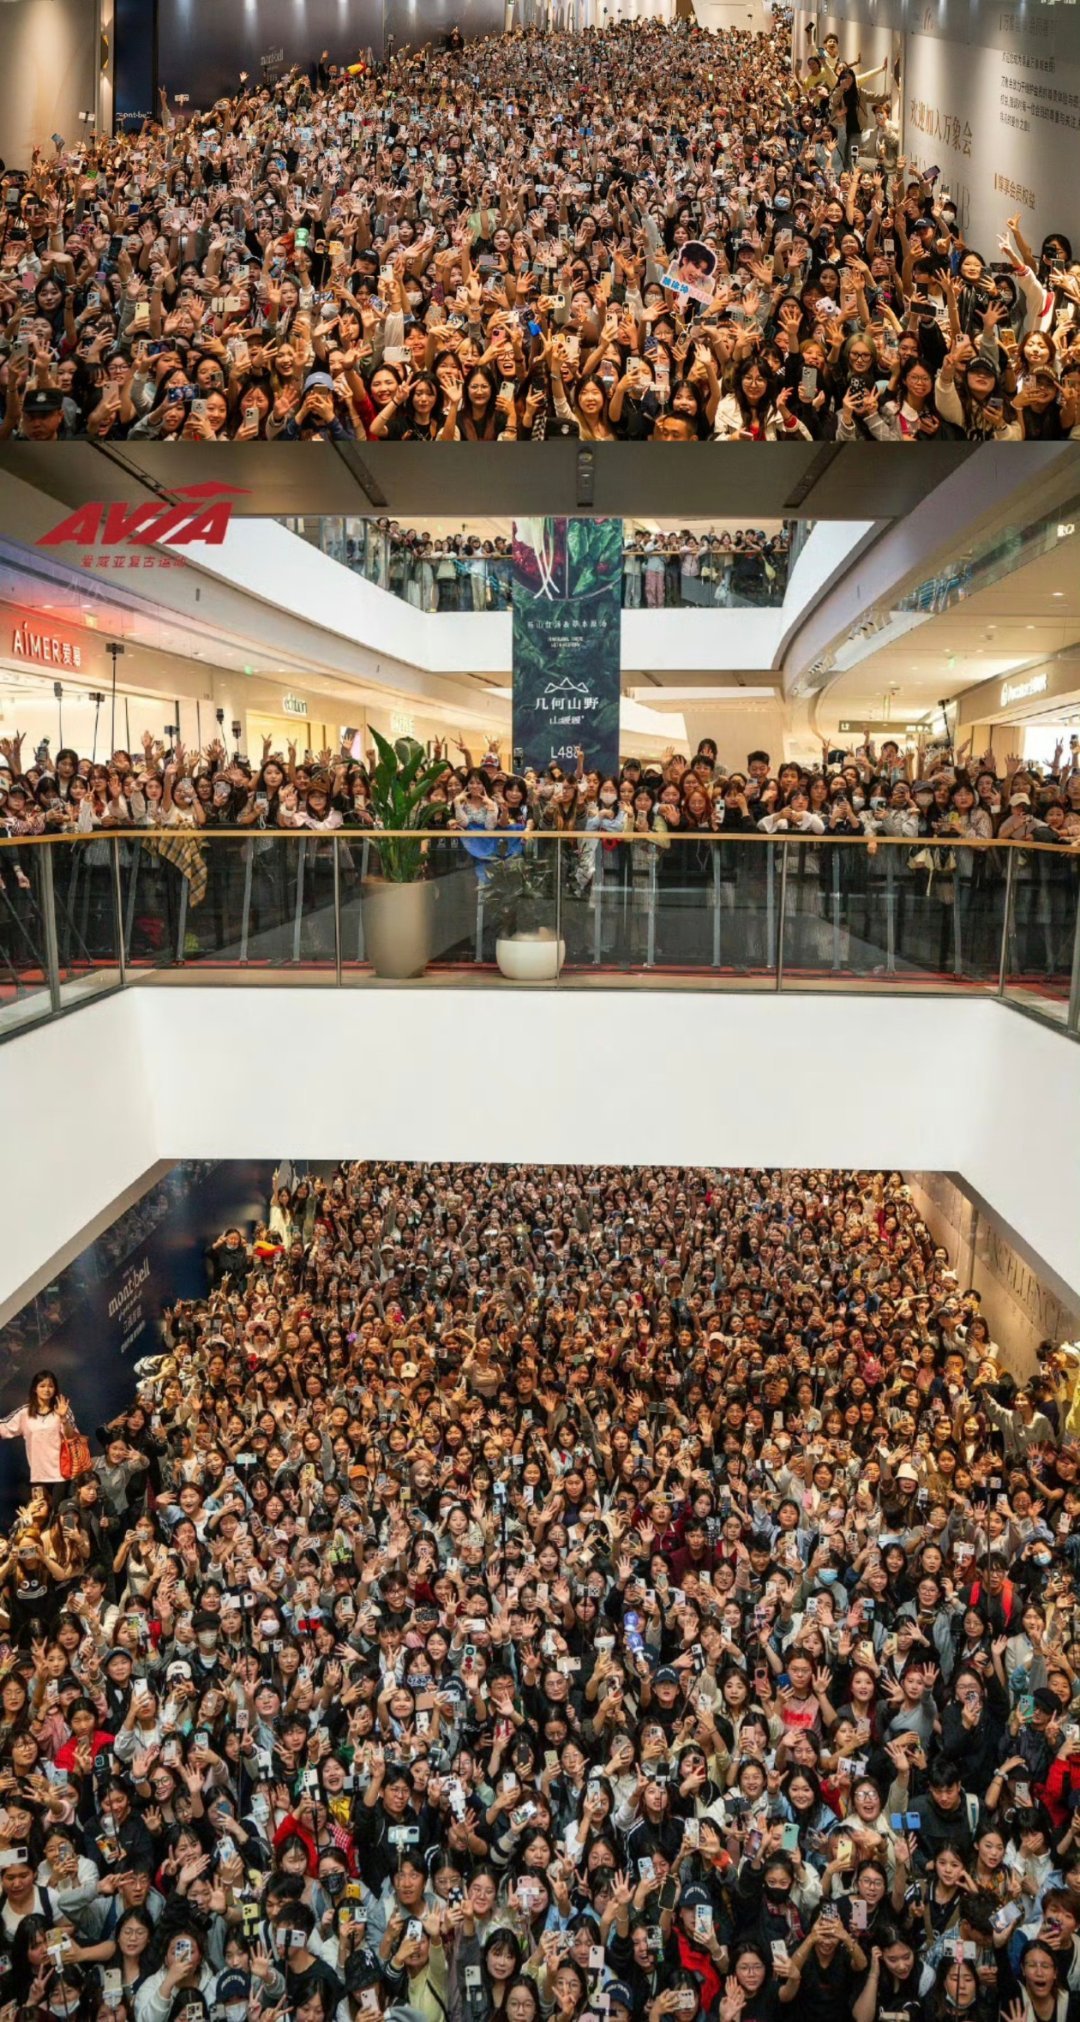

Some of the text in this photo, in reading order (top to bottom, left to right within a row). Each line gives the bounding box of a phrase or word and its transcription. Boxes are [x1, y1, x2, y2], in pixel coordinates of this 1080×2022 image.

[910, 98, 973, 158] 欢迎加入万象会
[534, 697, 599, 710] 几何山野
